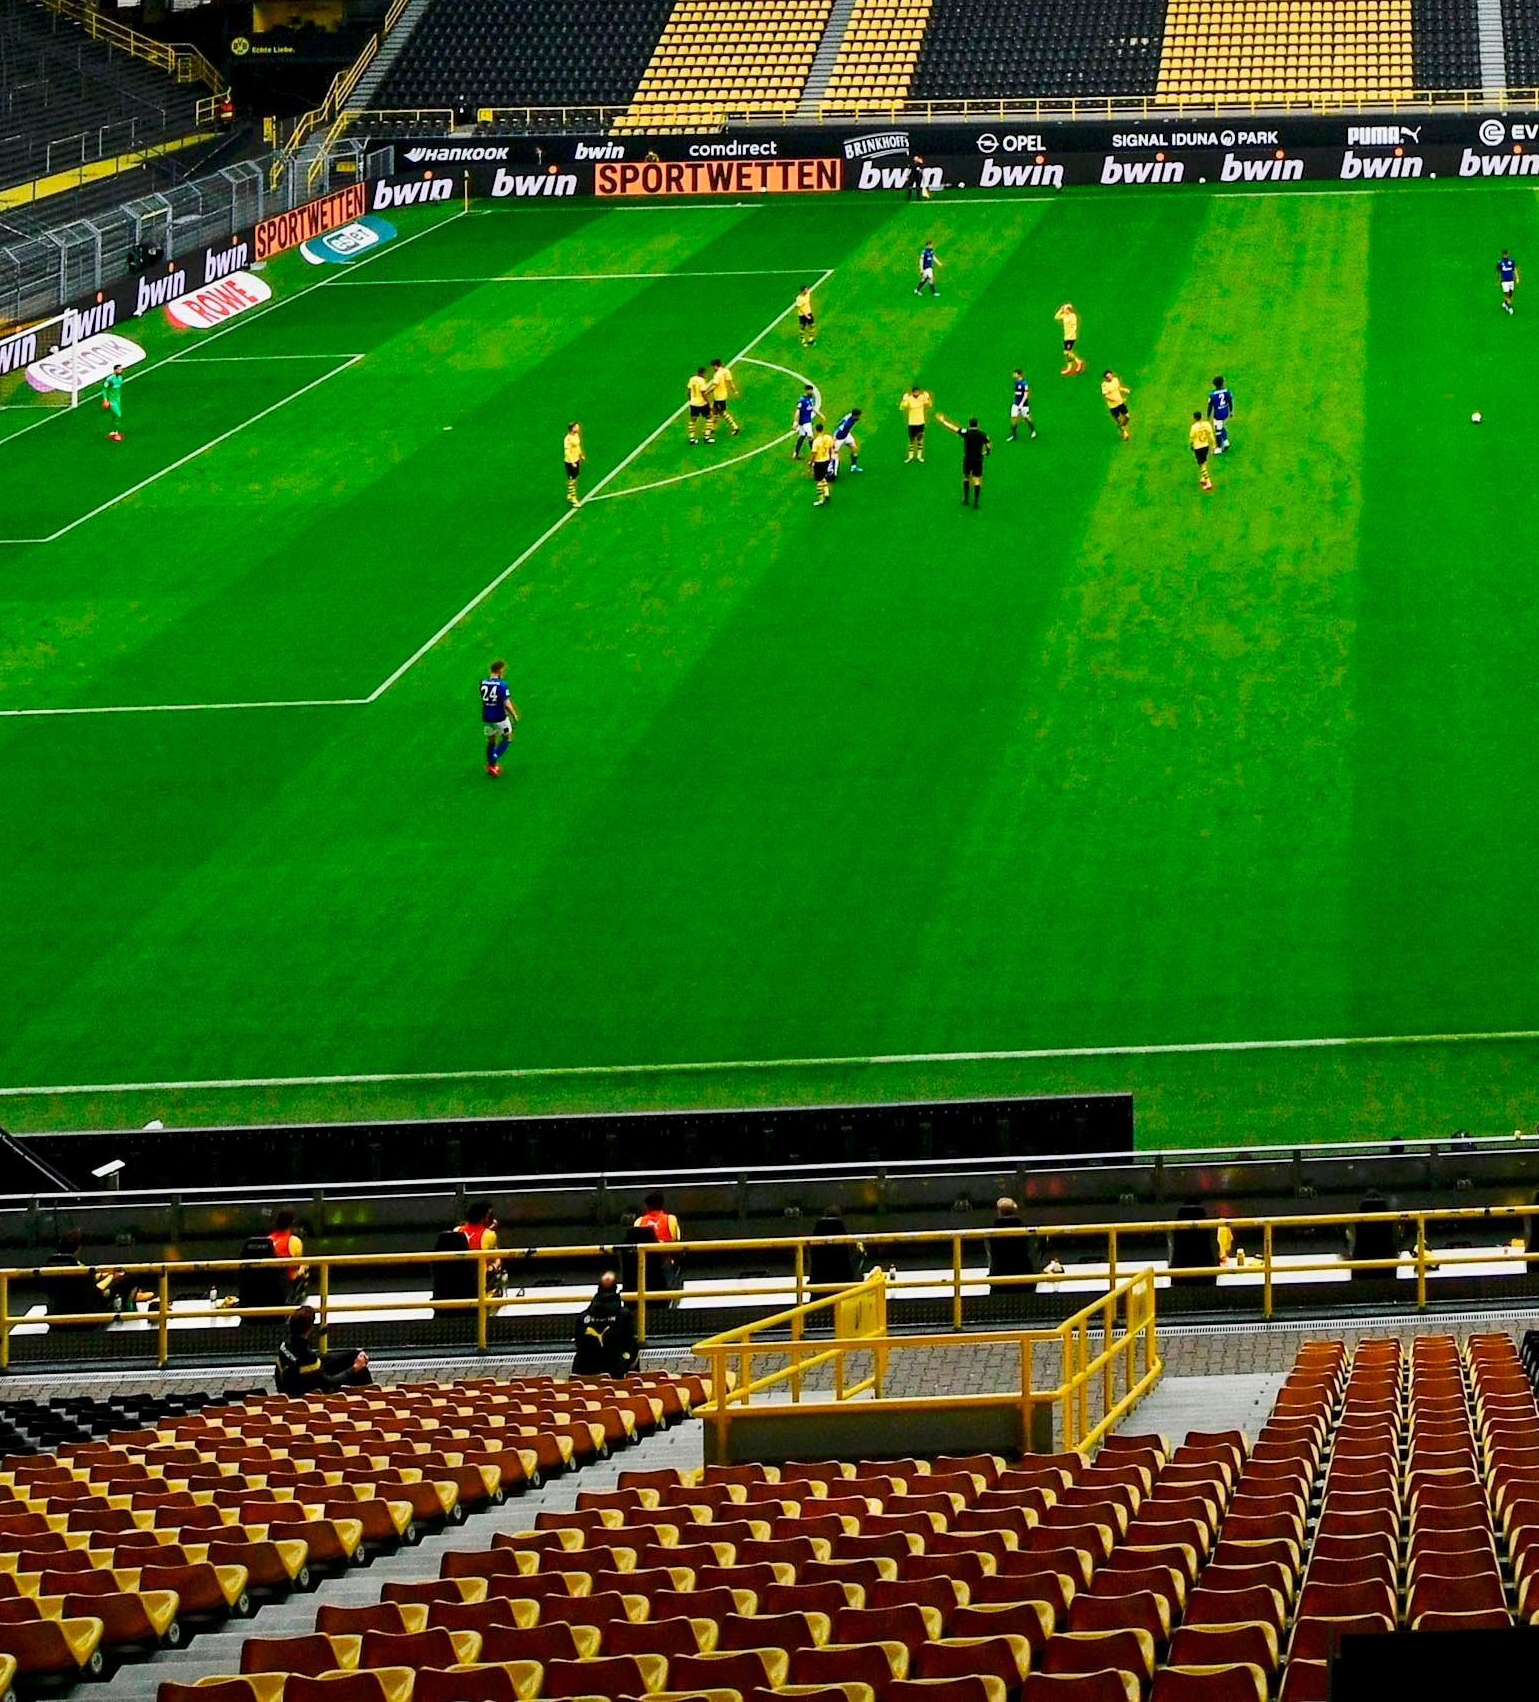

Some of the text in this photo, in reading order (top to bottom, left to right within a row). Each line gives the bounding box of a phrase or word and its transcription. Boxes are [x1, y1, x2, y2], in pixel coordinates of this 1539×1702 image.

[575, 141, 625, 160] bwin
[1002, 135, 1046, 152] OPEL
[1112, 131, 1278, 148] SIGNAL IDUNA PARK
[598, 161, 838, 196] SPORTWETTEN
[980, 155, 1066, 188] bwin
[1100, 152, 1185, 186] bwin
[1340, 147, 1423, 180] bwin
[371, 170, 454, 211] bwin
[492, 165, 577, 198] bwin
[256, 185, 364, 260] SPORTWETTEN
[204, 235, 248, 283] bwin
[136, 262, 188, 316] bwin
[196, 278, 257, 325] ROWE
[481, 685, 497, 701] 24
